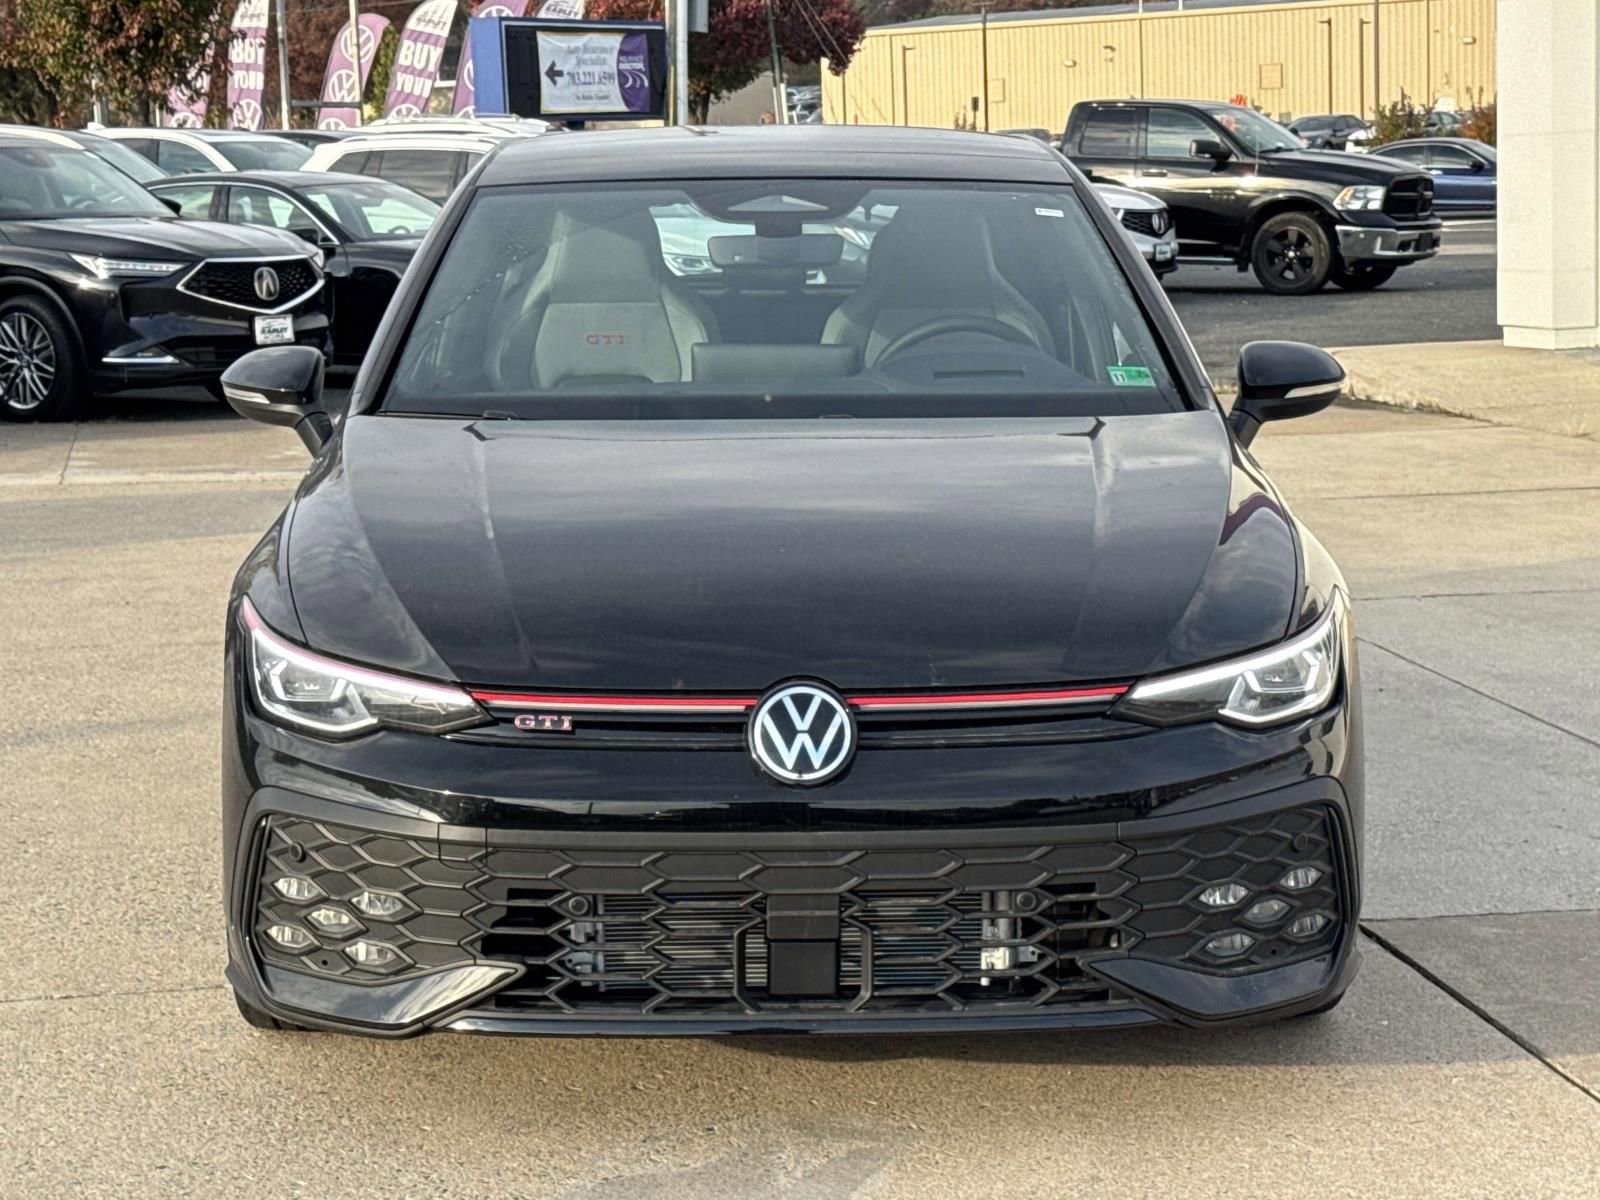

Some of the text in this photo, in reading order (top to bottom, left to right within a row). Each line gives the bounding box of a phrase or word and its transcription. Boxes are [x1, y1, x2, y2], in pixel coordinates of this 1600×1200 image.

[398, 39, 443, 73] BUY
[586, 335, 624, 345] GTI
[514, 714, 573, 731] GTI
